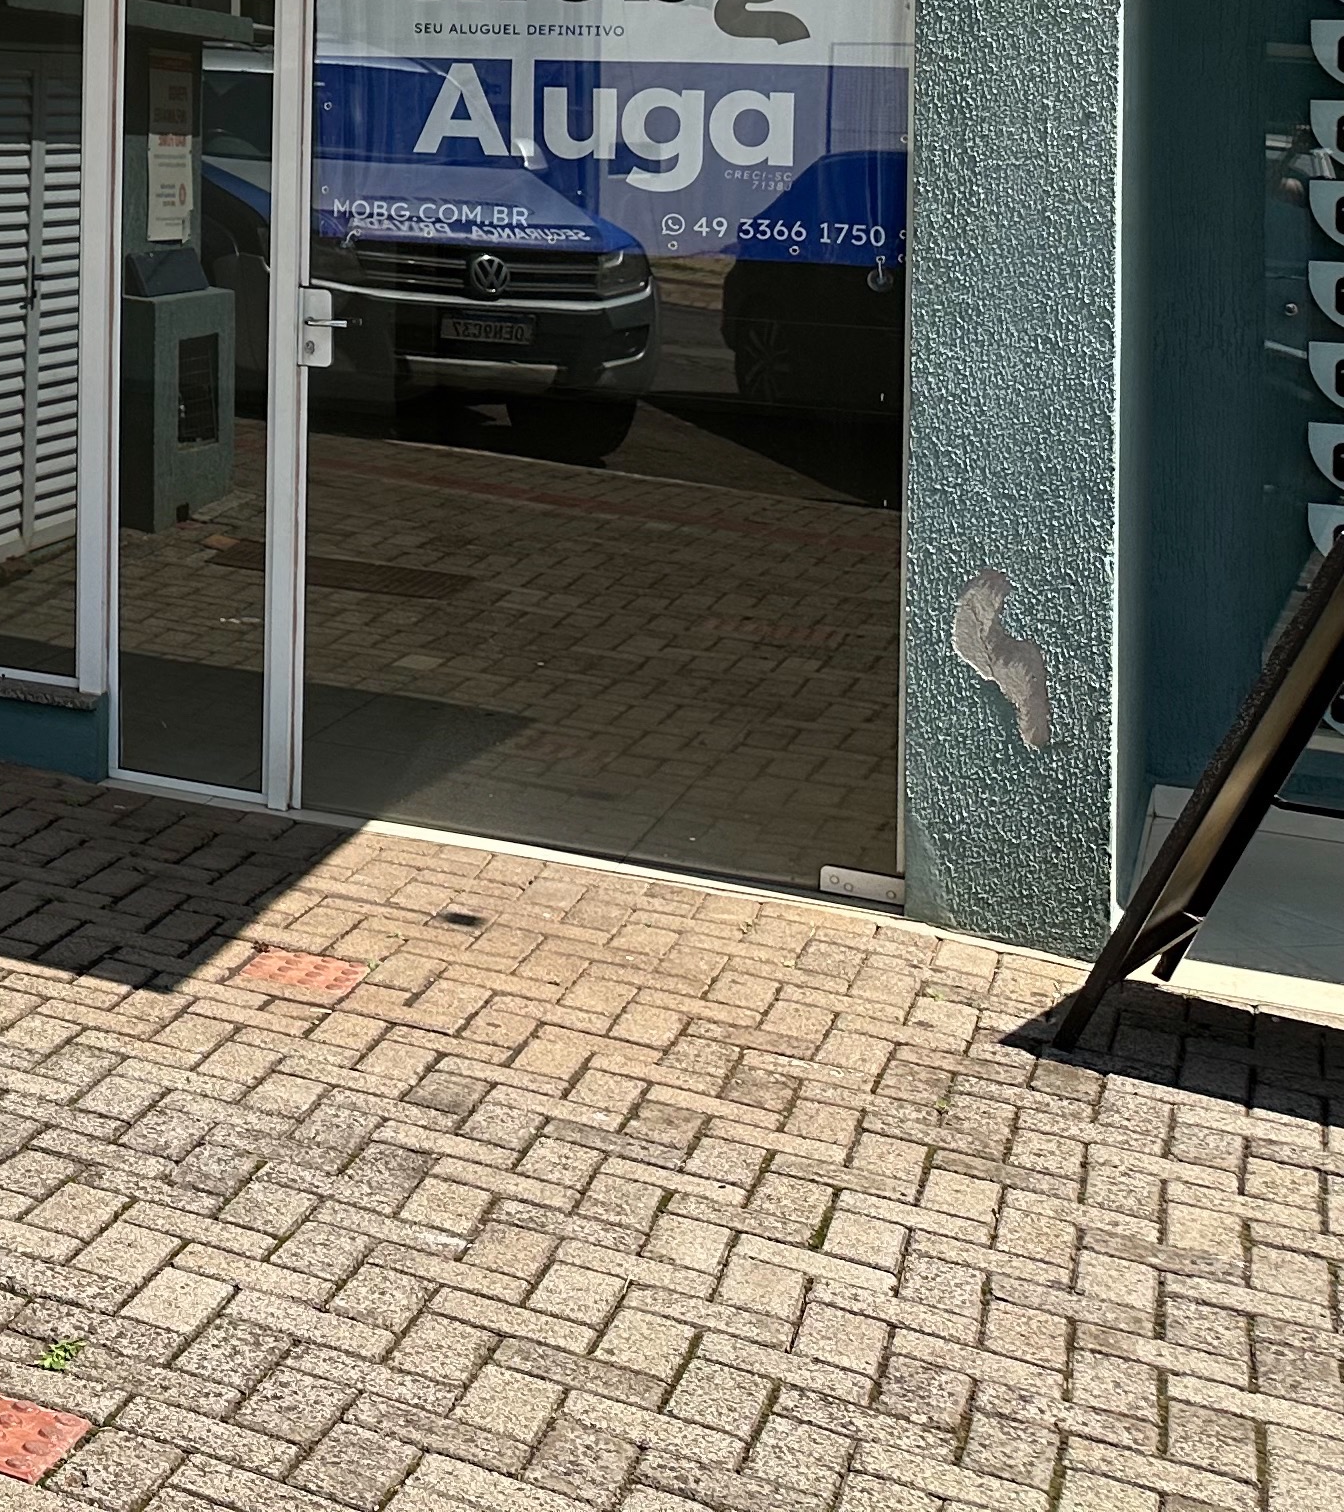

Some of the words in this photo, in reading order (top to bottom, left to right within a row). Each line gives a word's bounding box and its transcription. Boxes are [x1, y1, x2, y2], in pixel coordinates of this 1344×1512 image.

[414, 22, 443, 34] SEU
[448, 23, 520, 36] ALUGUEL
[526, 24, 625, 37] DEFINITIVO
[413, 56, 796, 193] Aluga
[724, 169, 793, 182] CRECI-SC
[333, 197, 529, 227] MOBG.COM.BR
[693, 216, 728, 237] 49
[739, 218, 807, 241] 3366
[819, 222, 886, 247] 1750
